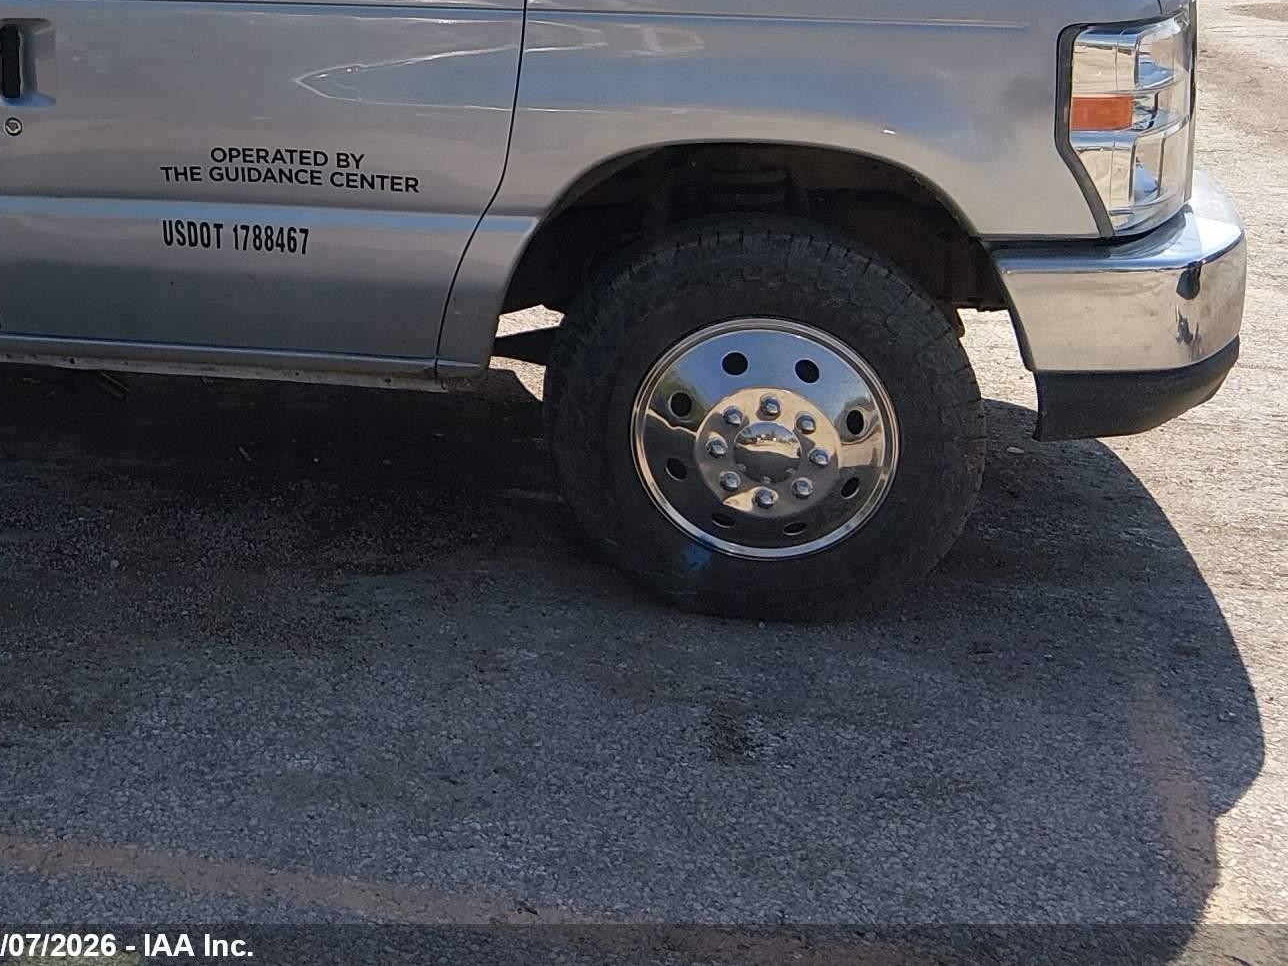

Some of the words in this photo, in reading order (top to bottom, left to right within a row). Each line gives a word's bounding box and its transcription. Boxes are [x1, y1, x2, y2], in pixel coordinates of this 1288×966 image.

[211, 147, 328, 167] OPERATED
[336, 152, 365, 169] BY
[160, 166, 202, 182] THE
[209, 167, 322, 185] GUIDANCE
[330, 171, 420, 193] CENTER
[162, 220, 223, 249] USDOT
[232, 224, 309, 254] 1788467
